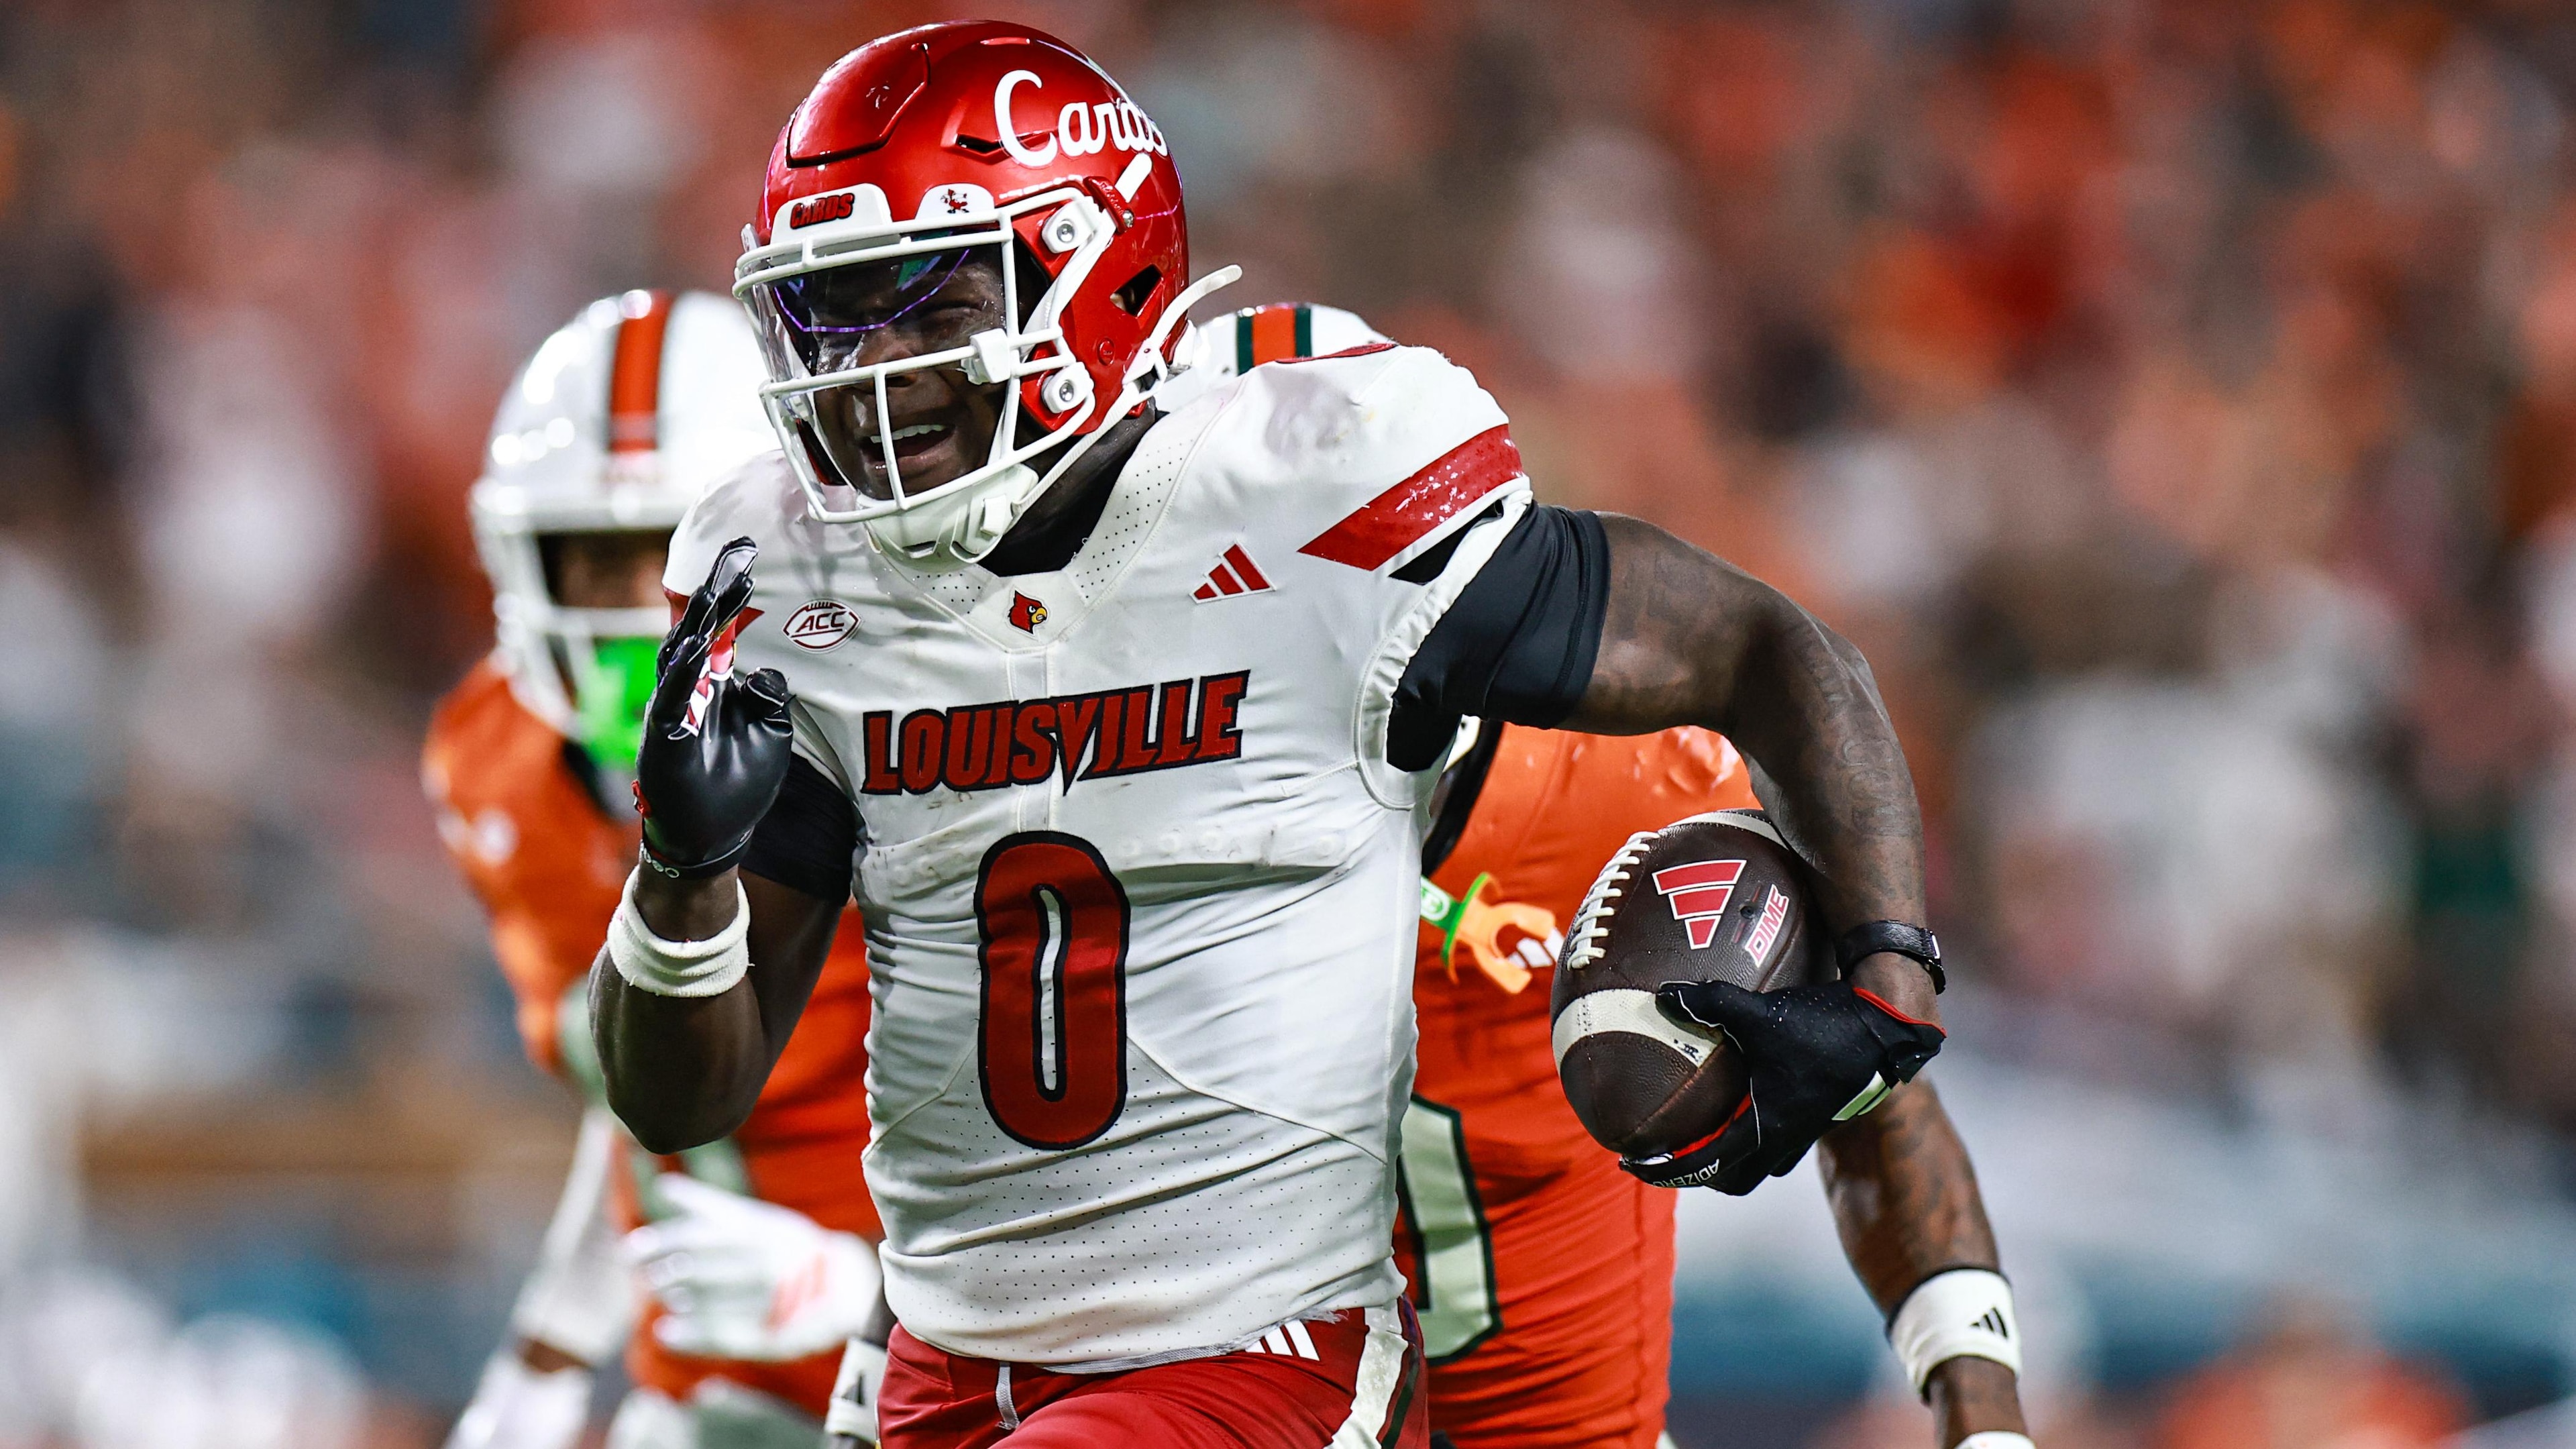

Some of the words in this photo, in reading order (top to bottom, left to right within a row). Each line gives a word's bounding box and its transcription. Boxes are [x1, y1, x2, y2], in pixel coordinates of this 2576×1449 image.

[994, 69, 1168, 167] Cards
[790, 193, 855, 229] CARDS
[796, 611, 846, 633] ACC
[861, 669, 1251, 796] LOUISVILLE
[1745, 883, 1789, 968] DIME
[974, 830, 1131, 1150] 0
